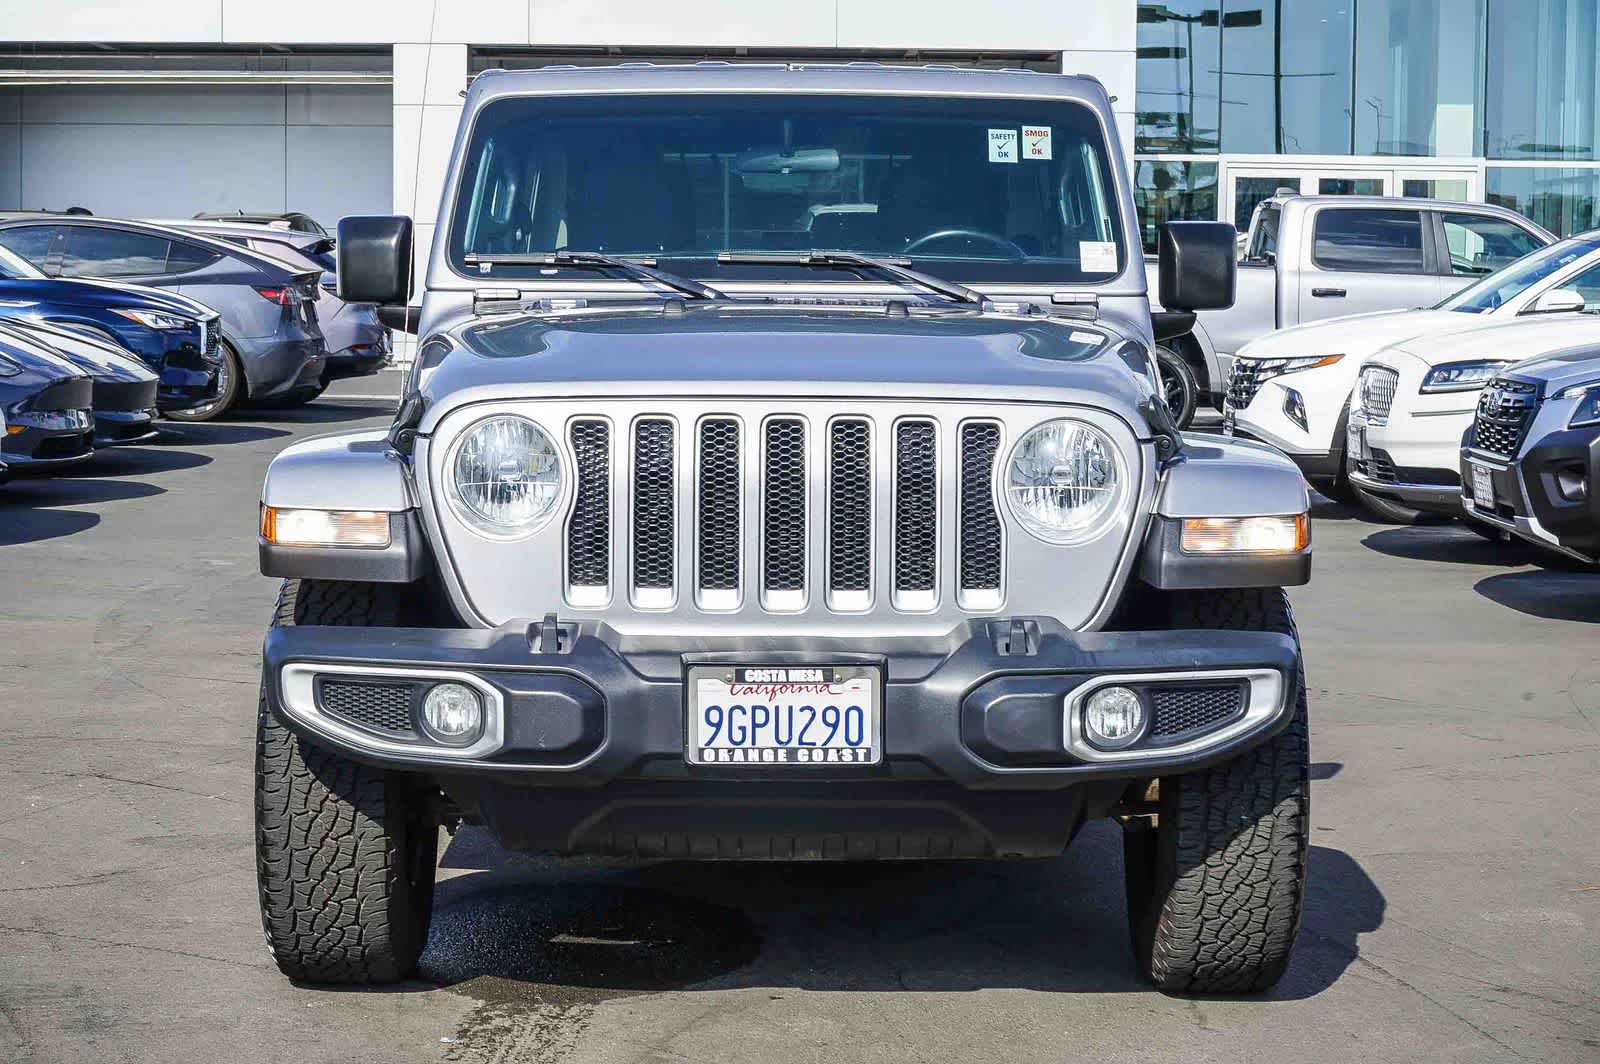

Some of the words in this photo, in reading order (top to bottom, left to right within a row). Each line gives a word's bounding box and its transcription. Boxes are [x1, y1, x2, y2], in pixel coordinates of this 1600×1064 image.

[744, 669, 787, 682] COSTA
[788, 669, 824, 682] MESA
[729, 683, 844, 702] California
[704, 705, 864, 747] 9GPU290
[703, 748, 788, 762] ORANGE
[797, 748, 867, 762] COAST
